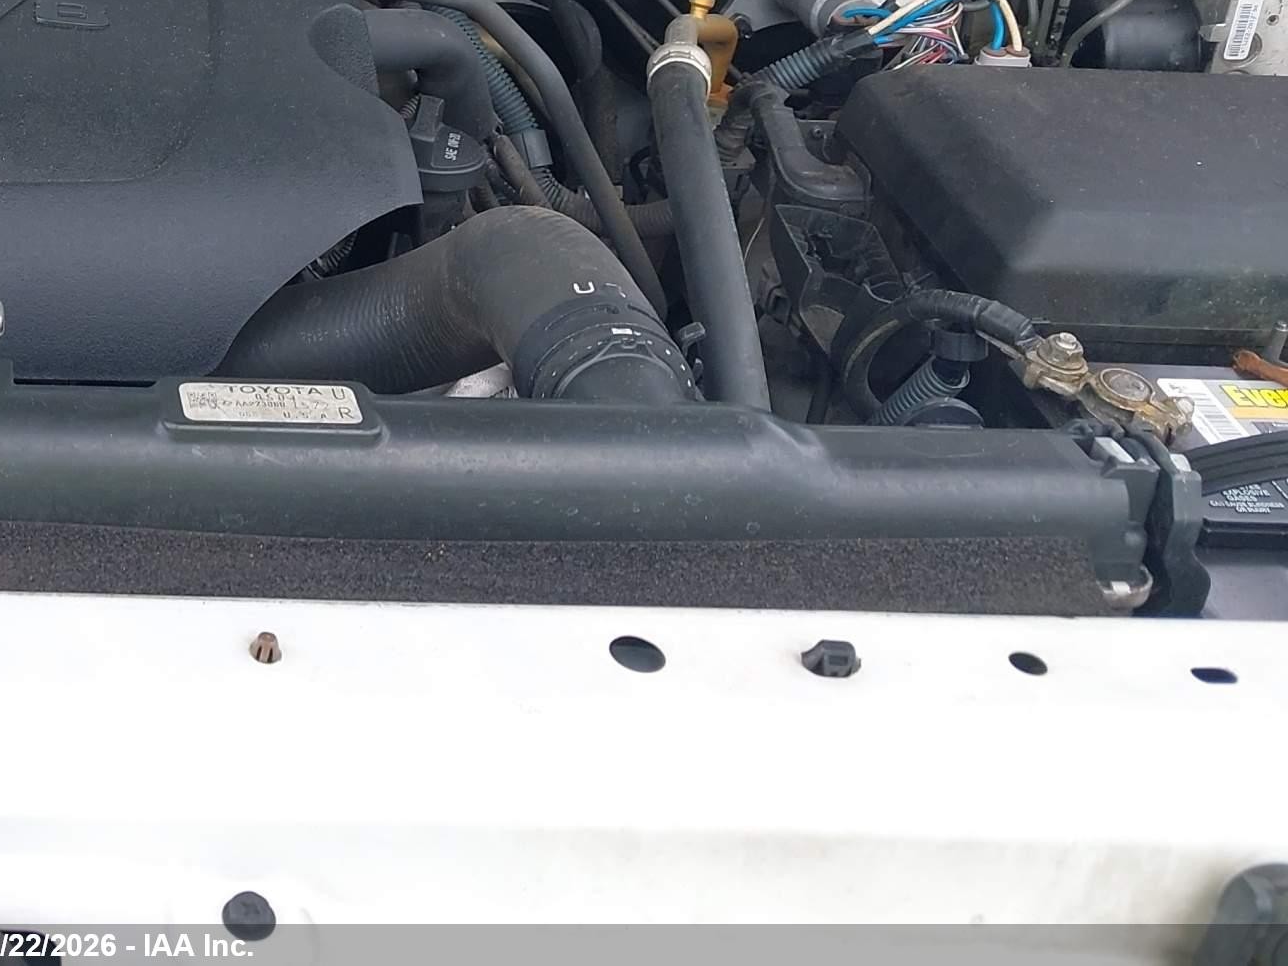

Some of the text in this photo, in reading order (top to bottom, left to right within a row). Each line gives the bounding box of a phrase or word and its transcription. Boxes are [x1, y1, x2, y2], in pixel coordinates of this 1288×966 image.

[444, 147, 457, 160] SAE
[224, 386, 347, 400] TOYOTA U
[338, 406, 354, 420] R
